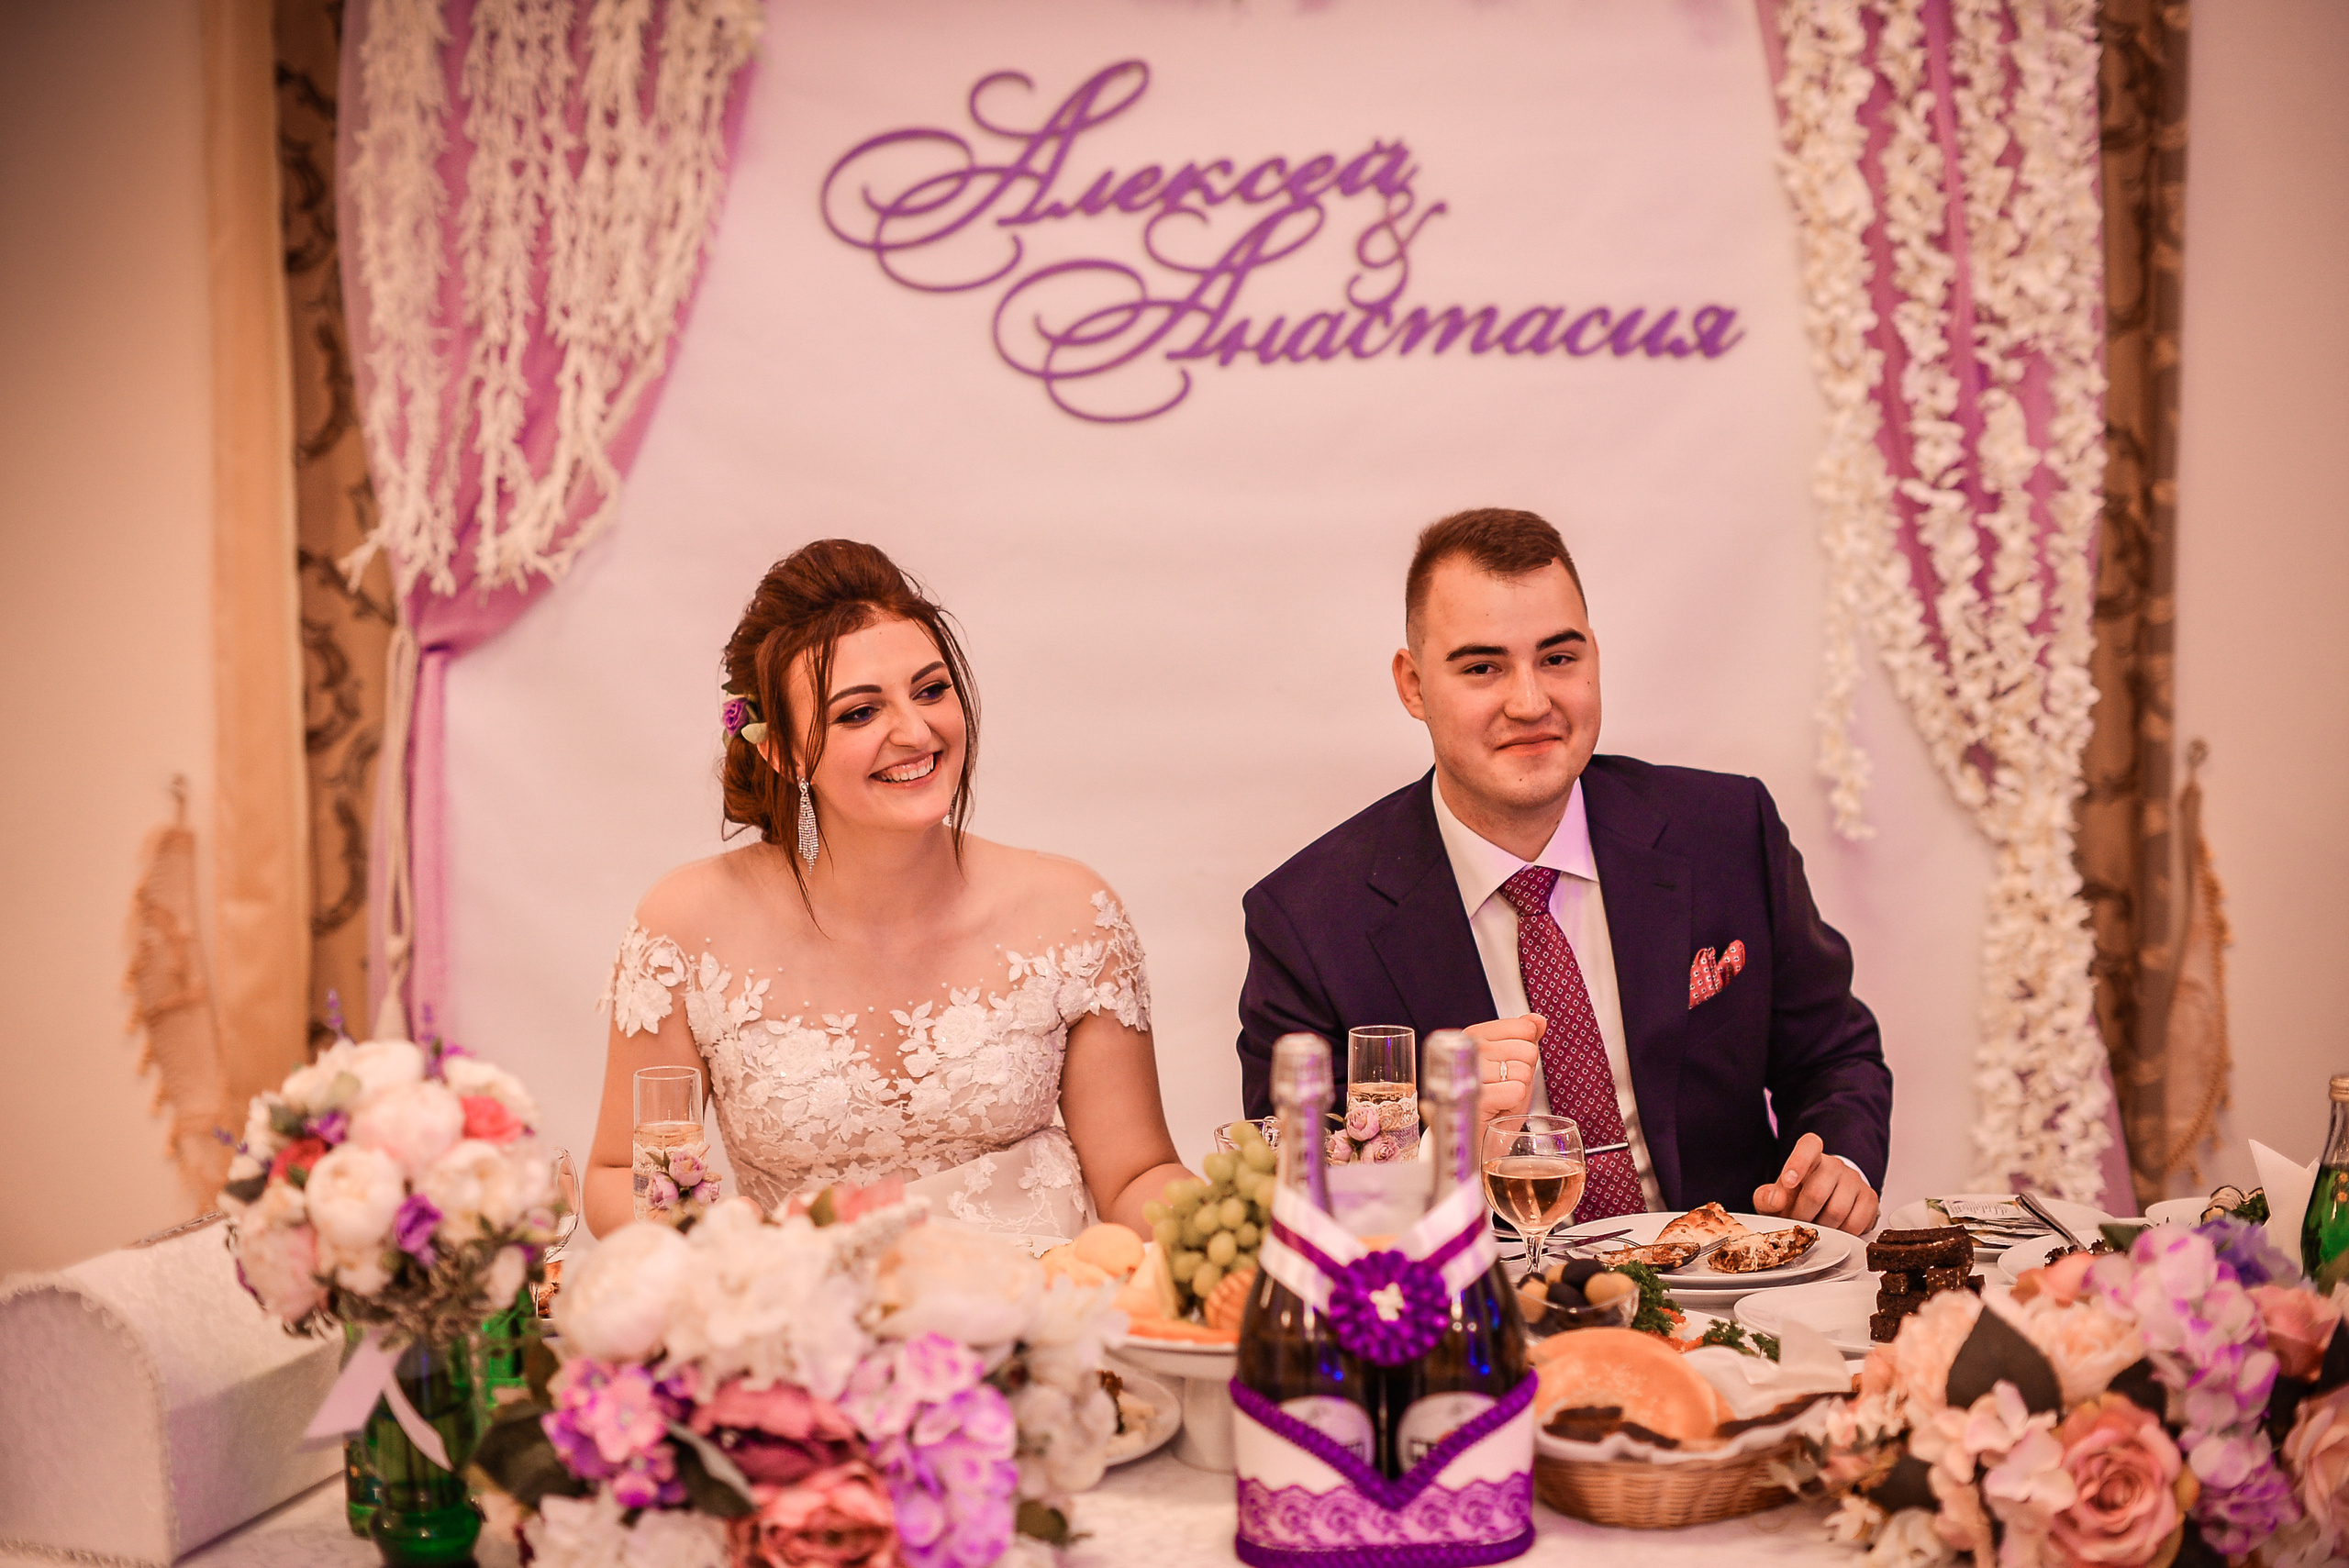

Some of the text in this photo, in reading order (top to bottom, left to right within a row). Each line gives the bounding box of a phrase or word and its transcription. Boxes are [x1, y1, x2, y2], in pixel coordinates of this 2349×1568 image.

[821, 59, 1419, 292] Алексей
[1347, 184, 1447, 312] &
[993, 198, 1745, 423] Анастасия
